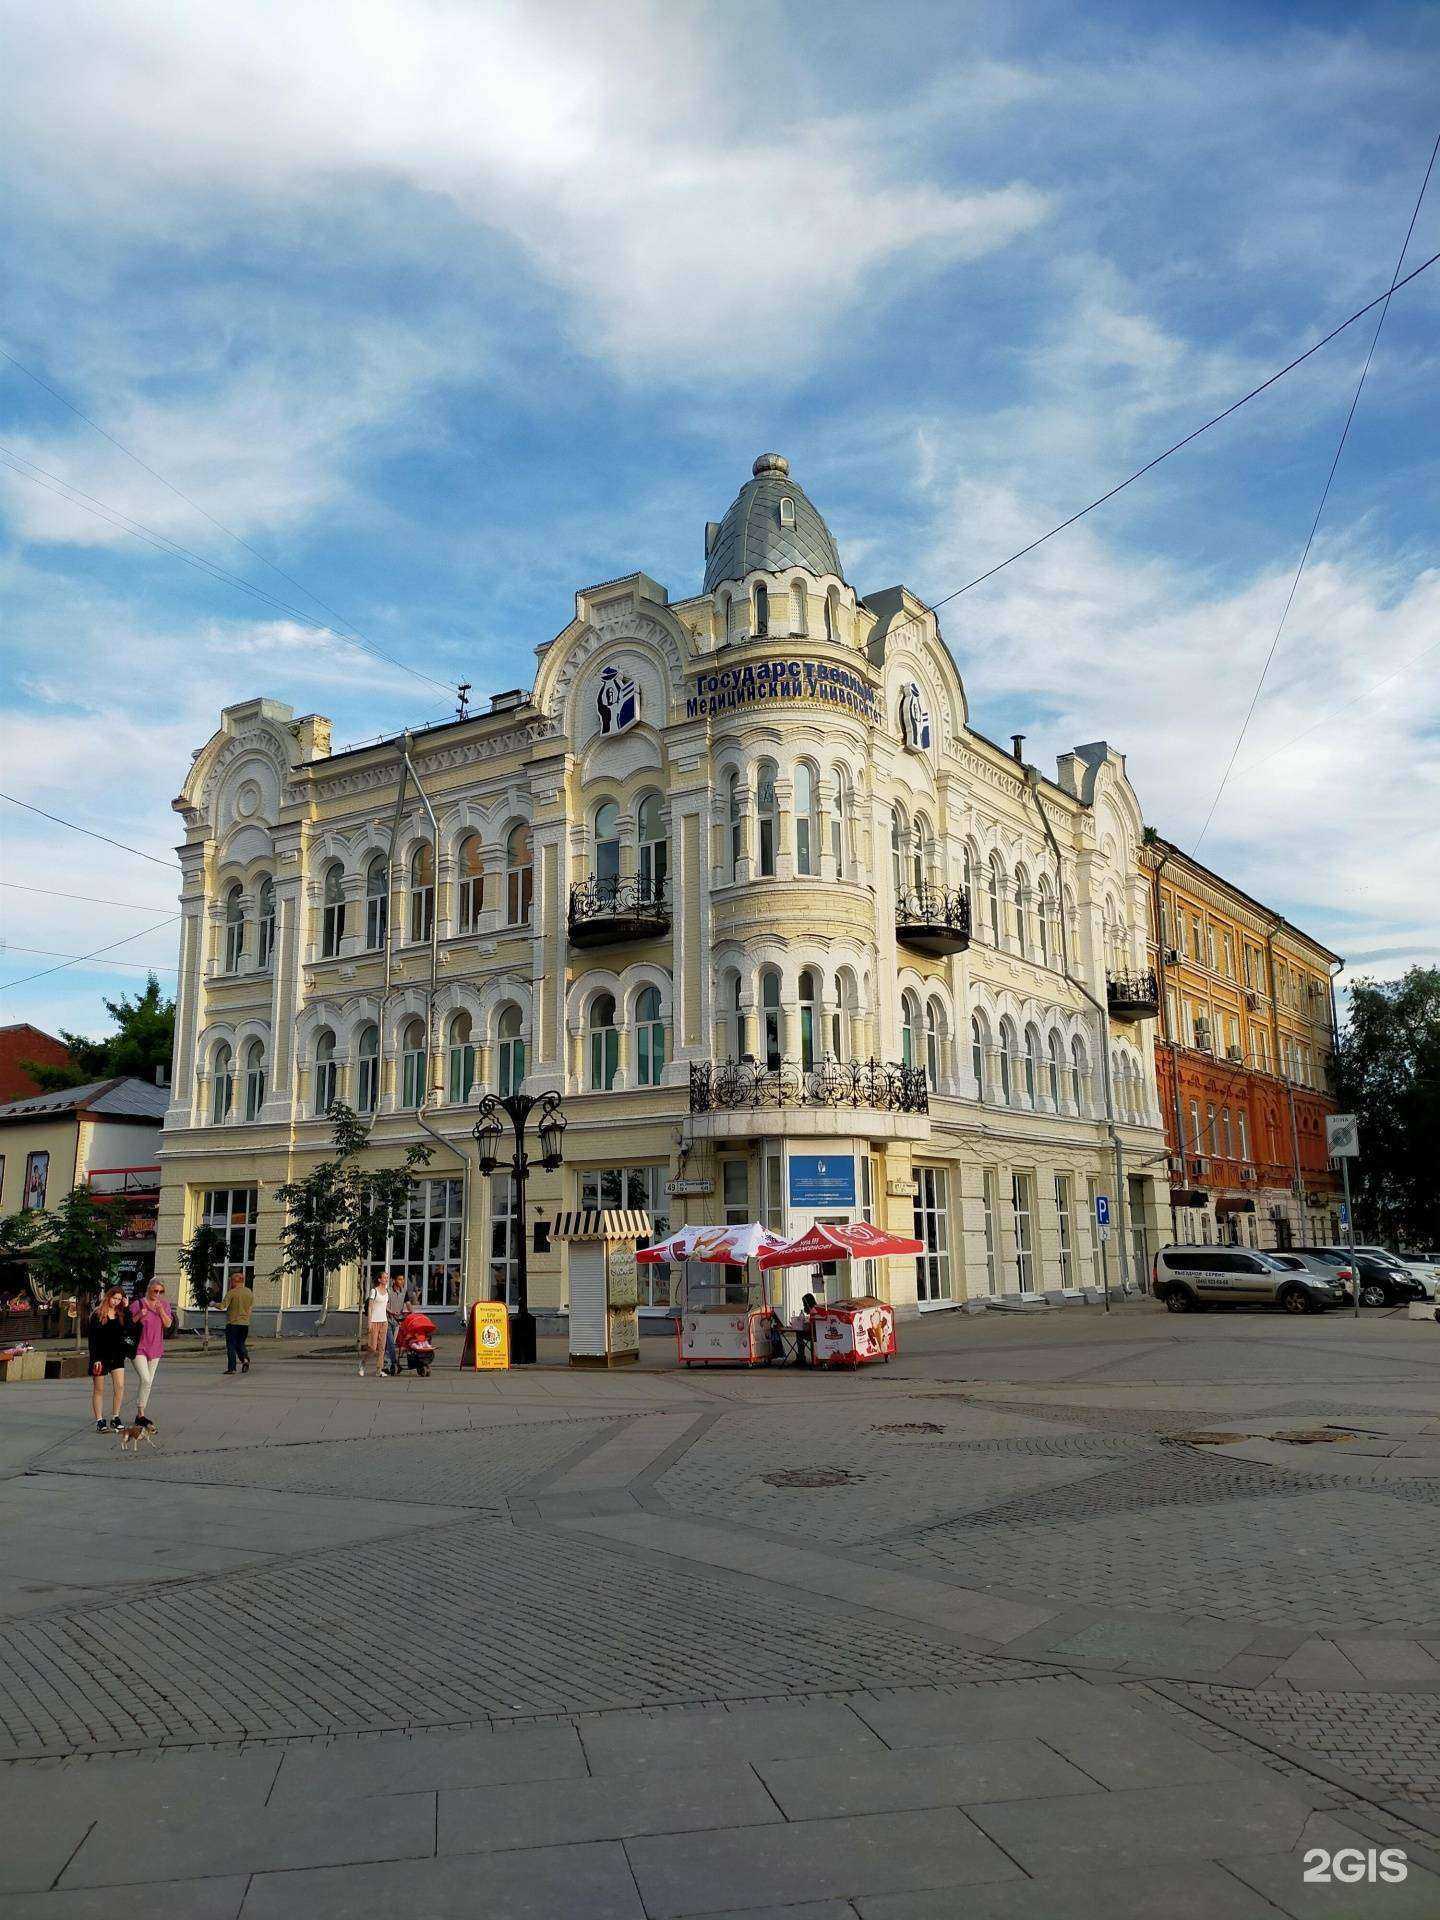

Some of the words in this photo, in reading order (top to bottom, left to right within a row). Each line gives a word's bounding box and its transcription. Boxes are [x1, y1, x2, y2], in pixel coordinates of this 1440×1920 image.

[686, 678, 802, 718] Медицинский
[807, 676, 882, 725] Университет
[695, 661, 876, 704] Государственный
[1099, 1199, 1107, 1222] P
